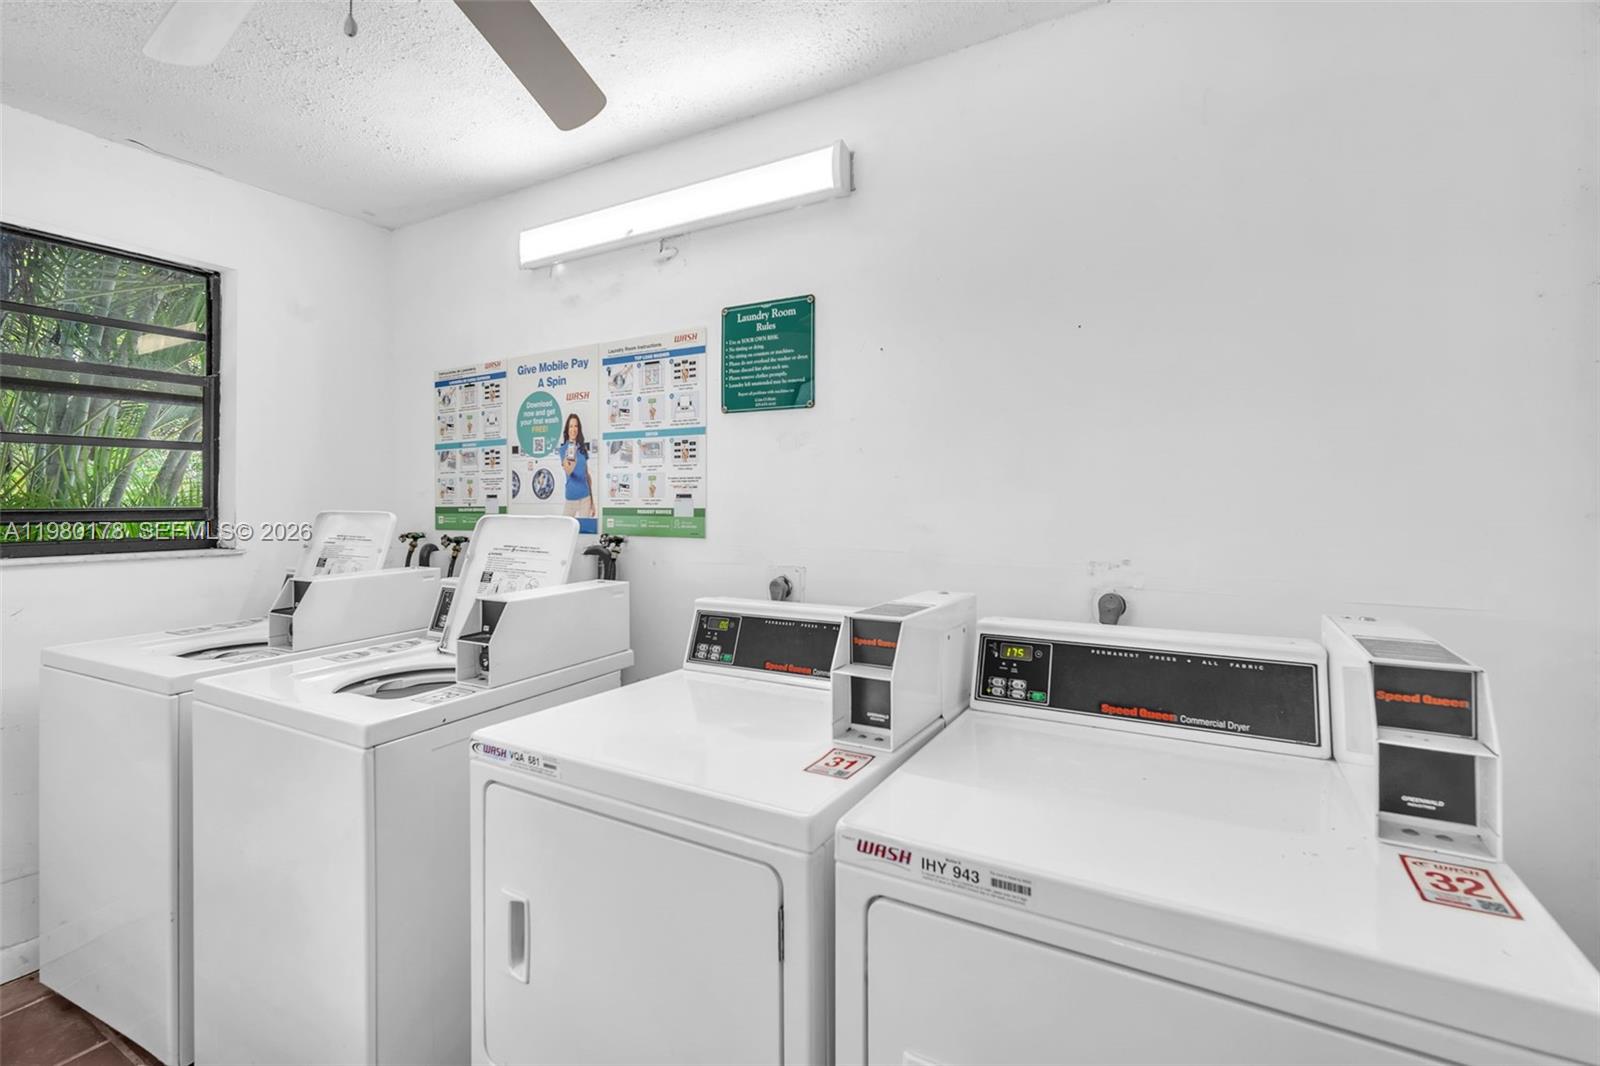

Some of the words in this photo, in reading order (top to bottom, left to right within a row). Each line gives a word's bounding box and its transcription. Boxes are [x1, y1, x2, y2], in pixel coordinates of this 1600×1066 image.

[737, 310, 769, 323] Laundry
[772, 308, 796, 318] Room
[756, 321, 776, 331] Rules
[674, 332, 698, 342] WASH
[518, 365, 536, 375] Give
[539, 360, 568, 372] Mobile
[571, 358, 589, 369] Pay
[538, 378, 544, 387] A
[546, 376, 566, 388] Spin
[566, 391, 590, 401] WASH
[526, 400, 552, 408] Download
[520, 419, 532, 427] your
[853, 636, 876, 646] Speed
[1090, 649, 1140, 658] PERMANENT
[1149, 654, 1177, 662] PRESS
[1229, 662, 1264, 671] FABRIC
[765, 662, 788, 671] Speed
[788, 664, 812, 674] Queen
[1375, 690, 1420, 703] Speed
[1422, 694, 1470, 708] Queen
[1100, 703, 1137, 717] Speed
[1138, 708, 1176, 722] Queen
[1180, 714, 1227, 729] Commercial
[1228, 720, 1251, 732] Dryer
[482, 744, 507, 758] WASH
[824, 756, 858, 770] 31
[856, 838, 912, 864] WASH
[921, 856, 947, 875] IHY
[952, 866, 980, 884] 943
[1425, 871, 1493, 899] 32
